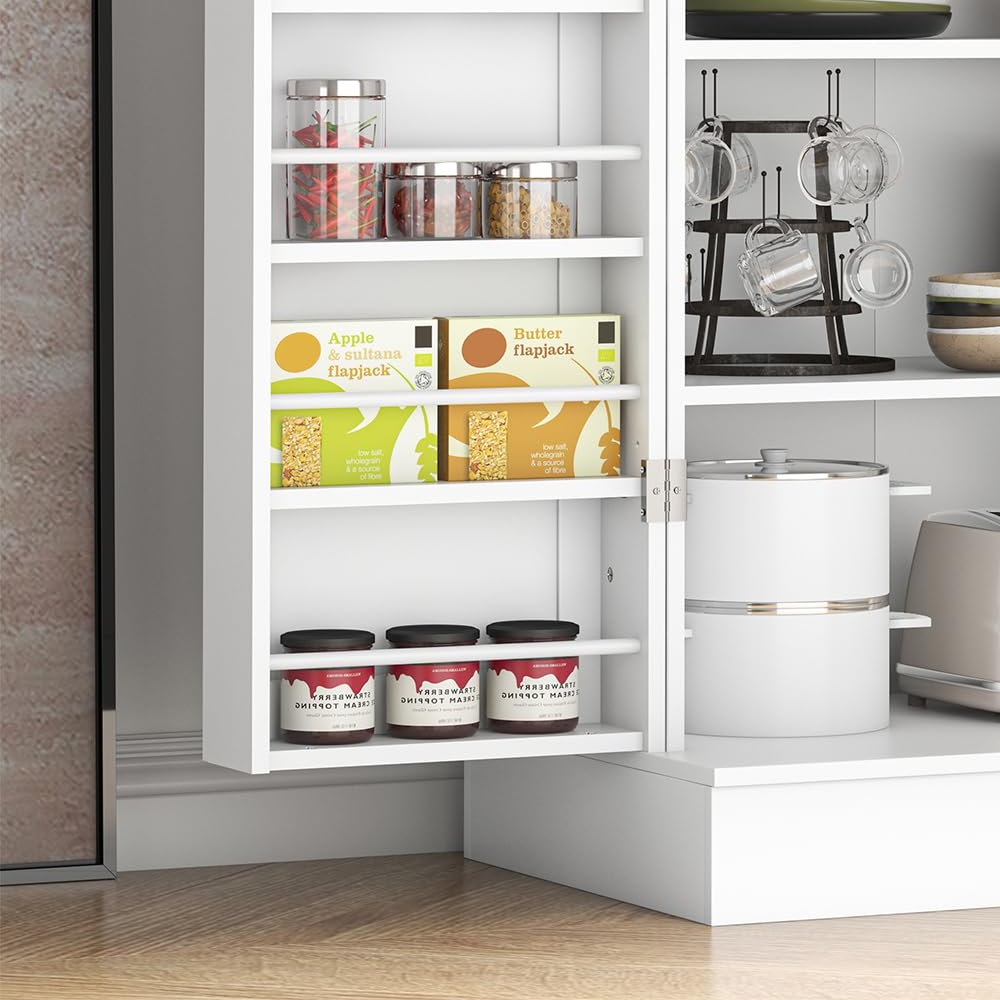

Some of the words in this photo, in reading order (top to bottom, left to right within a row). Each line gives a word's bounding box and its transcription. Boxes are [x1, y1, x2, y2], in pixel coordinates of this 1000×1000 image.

[328, 331, 374, 347] Apple
[514, 328, 562, 340] Butter
[328, 348, 340, 360] &
[344, 348, 402, 360] sultana
[514, 343, 574, 358] flapjack
[328, 364, 391, 380] flapjack
